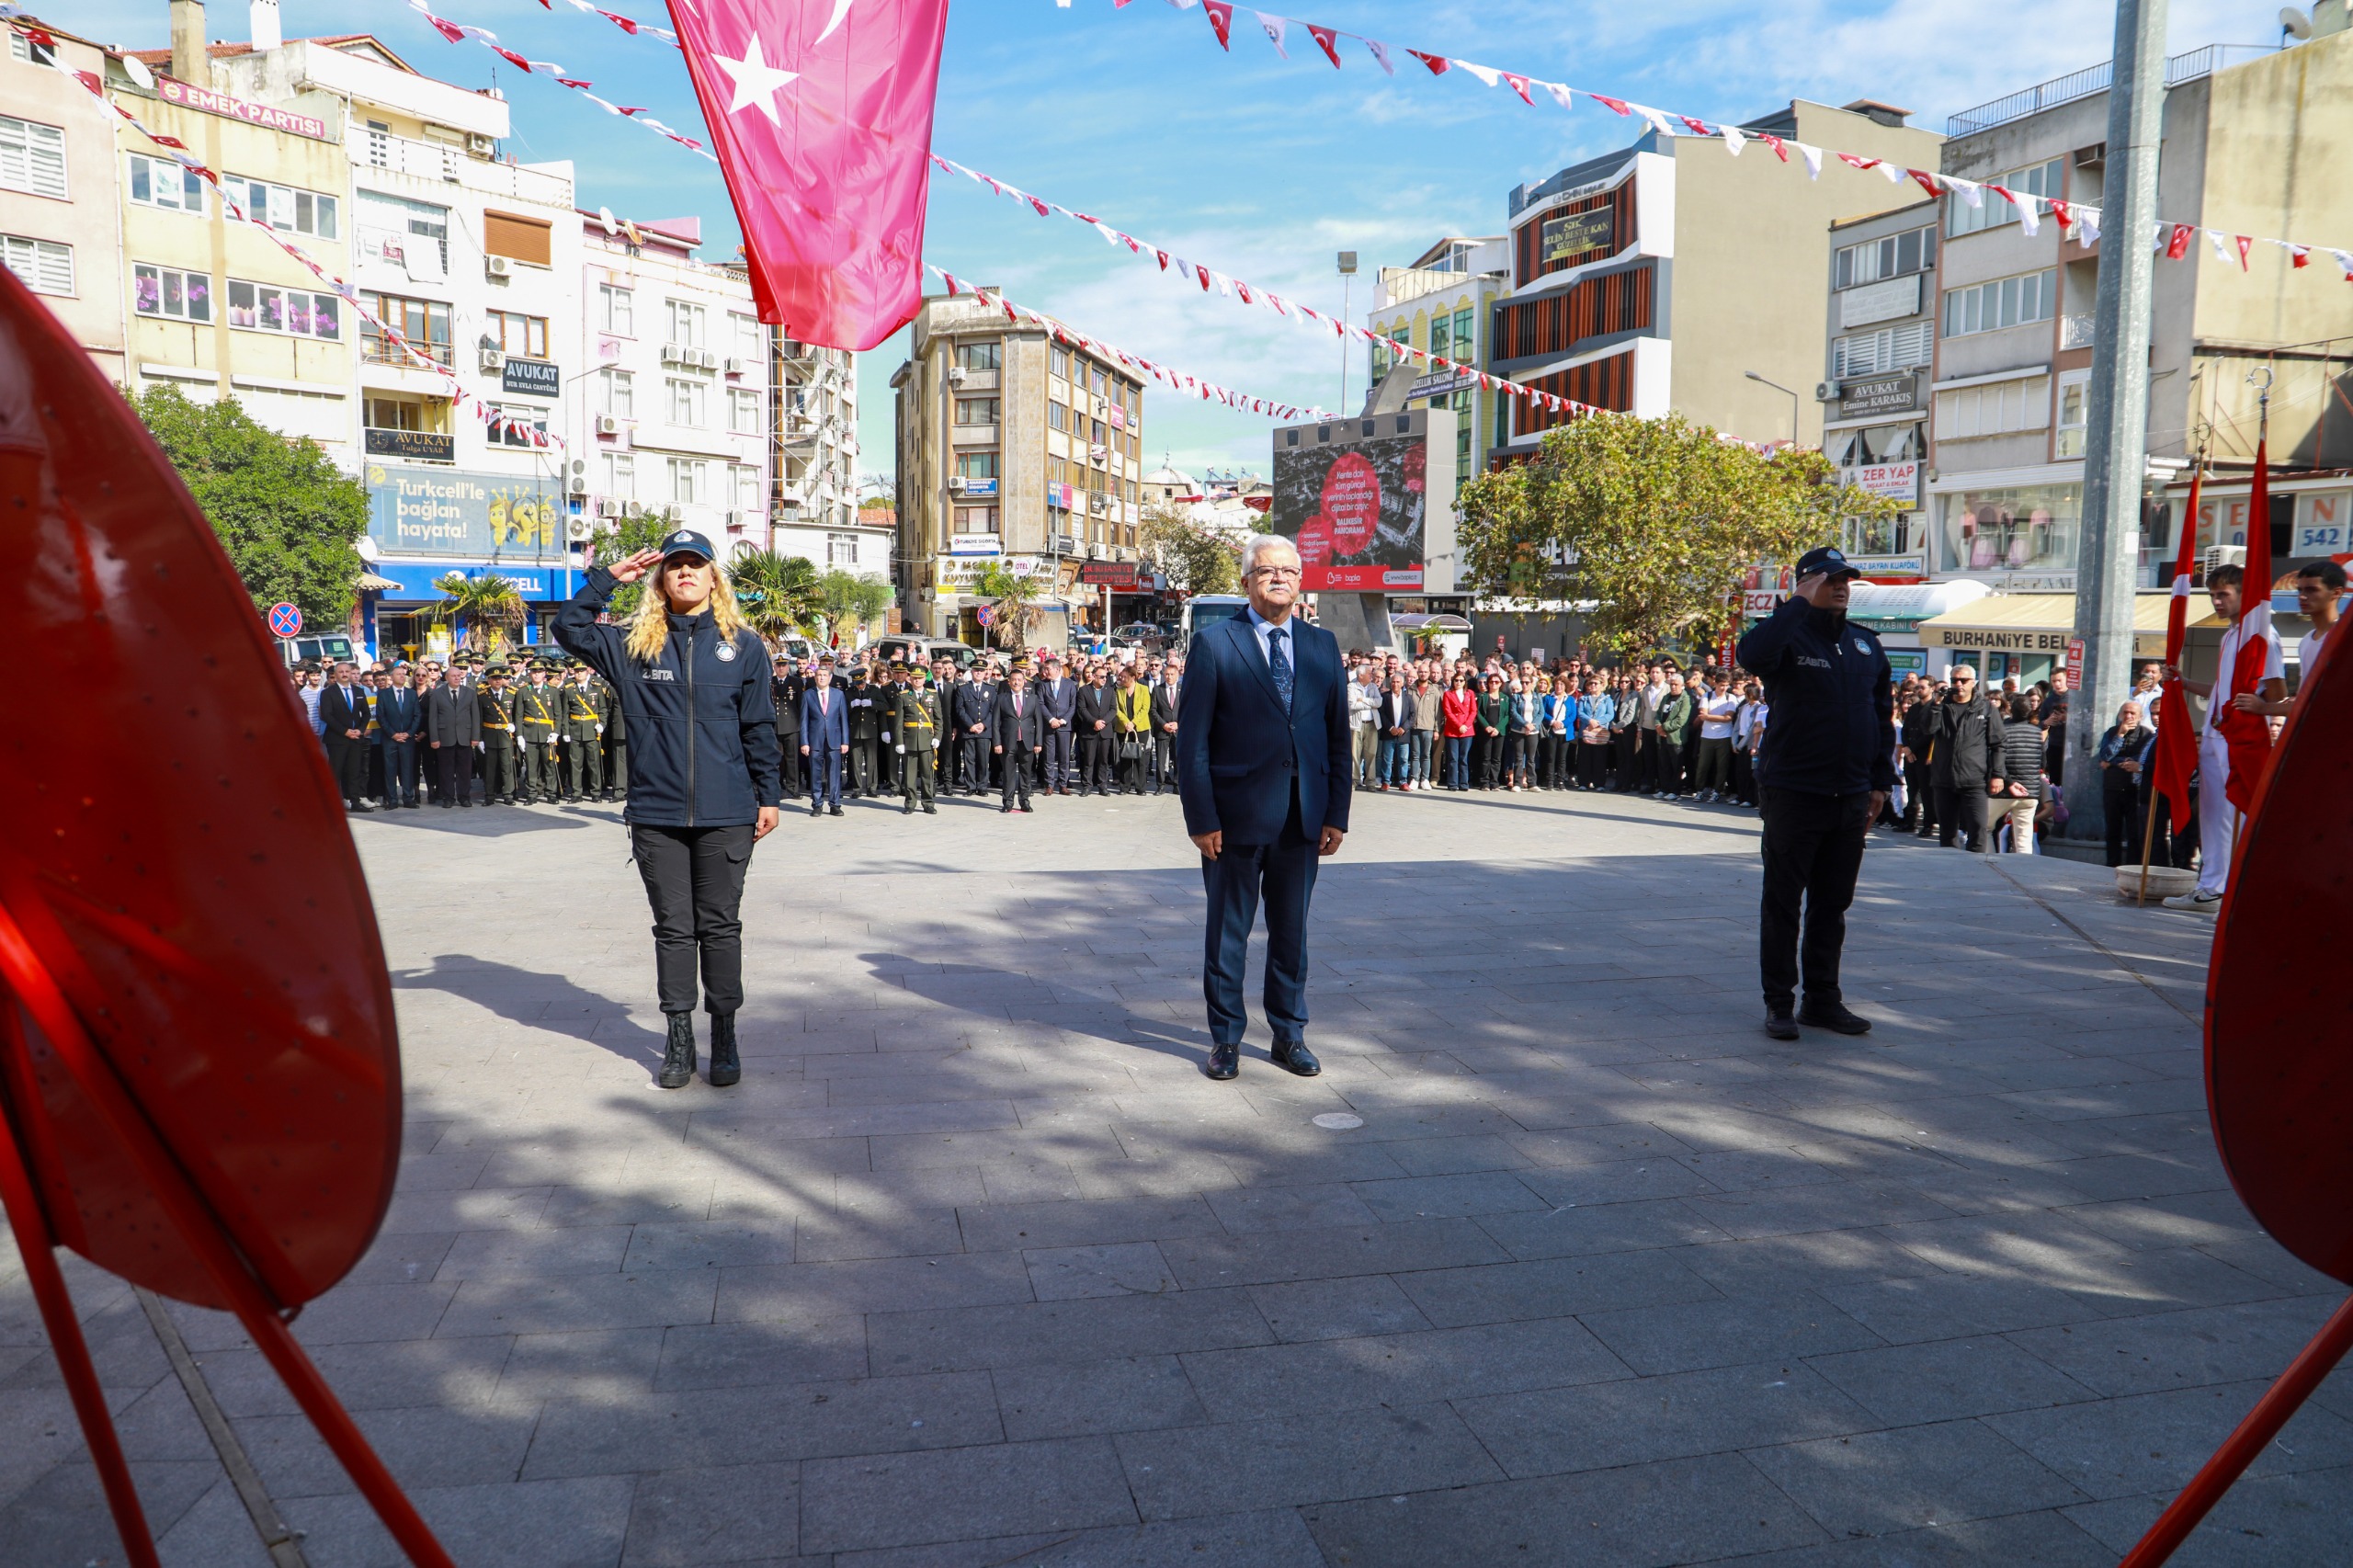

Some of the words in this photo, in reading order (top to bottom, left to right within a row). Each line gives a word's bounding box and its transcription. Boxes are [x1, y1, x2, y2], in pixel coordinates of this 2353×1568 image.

[187, 88, 243, 117] EMEK
[1590, 222, 1609, 233] KAN
[506, 362, 557, 381] AVUKAT
[506, 380, 518, 388] NUR
[1855, 381, 1901, 397] AVUKAT
[1843, 399, 1870, 410] Emine
[1870, 392, 1912, 406] KARAKIŞ
[395, 432, 451, 448] AVUKAT
[402, 445, 421, 453] Tulga
[423, 446, 444, 454] UYAR
[1353, 469, 1364, 478] dair
[1863, 468, 1886, 482] ZER
[1889, 465, 1915, 479] YAP
[396, 478, 484, 500] Turkcell'le
[1336, 482, 1347, 490] tüm
[1347, 480, 1366, 491] güncel
[396, 497, 460, 521] bağlan
[396, 517, 467, 540] hayata!
[1336, 516, 1363, 526] BALIKESİR
[1335, 527, 1366, 535] PANORAMA
[2302, 528, 2340, 547] 542
[1869, 562, 1889, 570] BAYAN
[1890, 559, 1920, 569] KUAFÖRÜ
